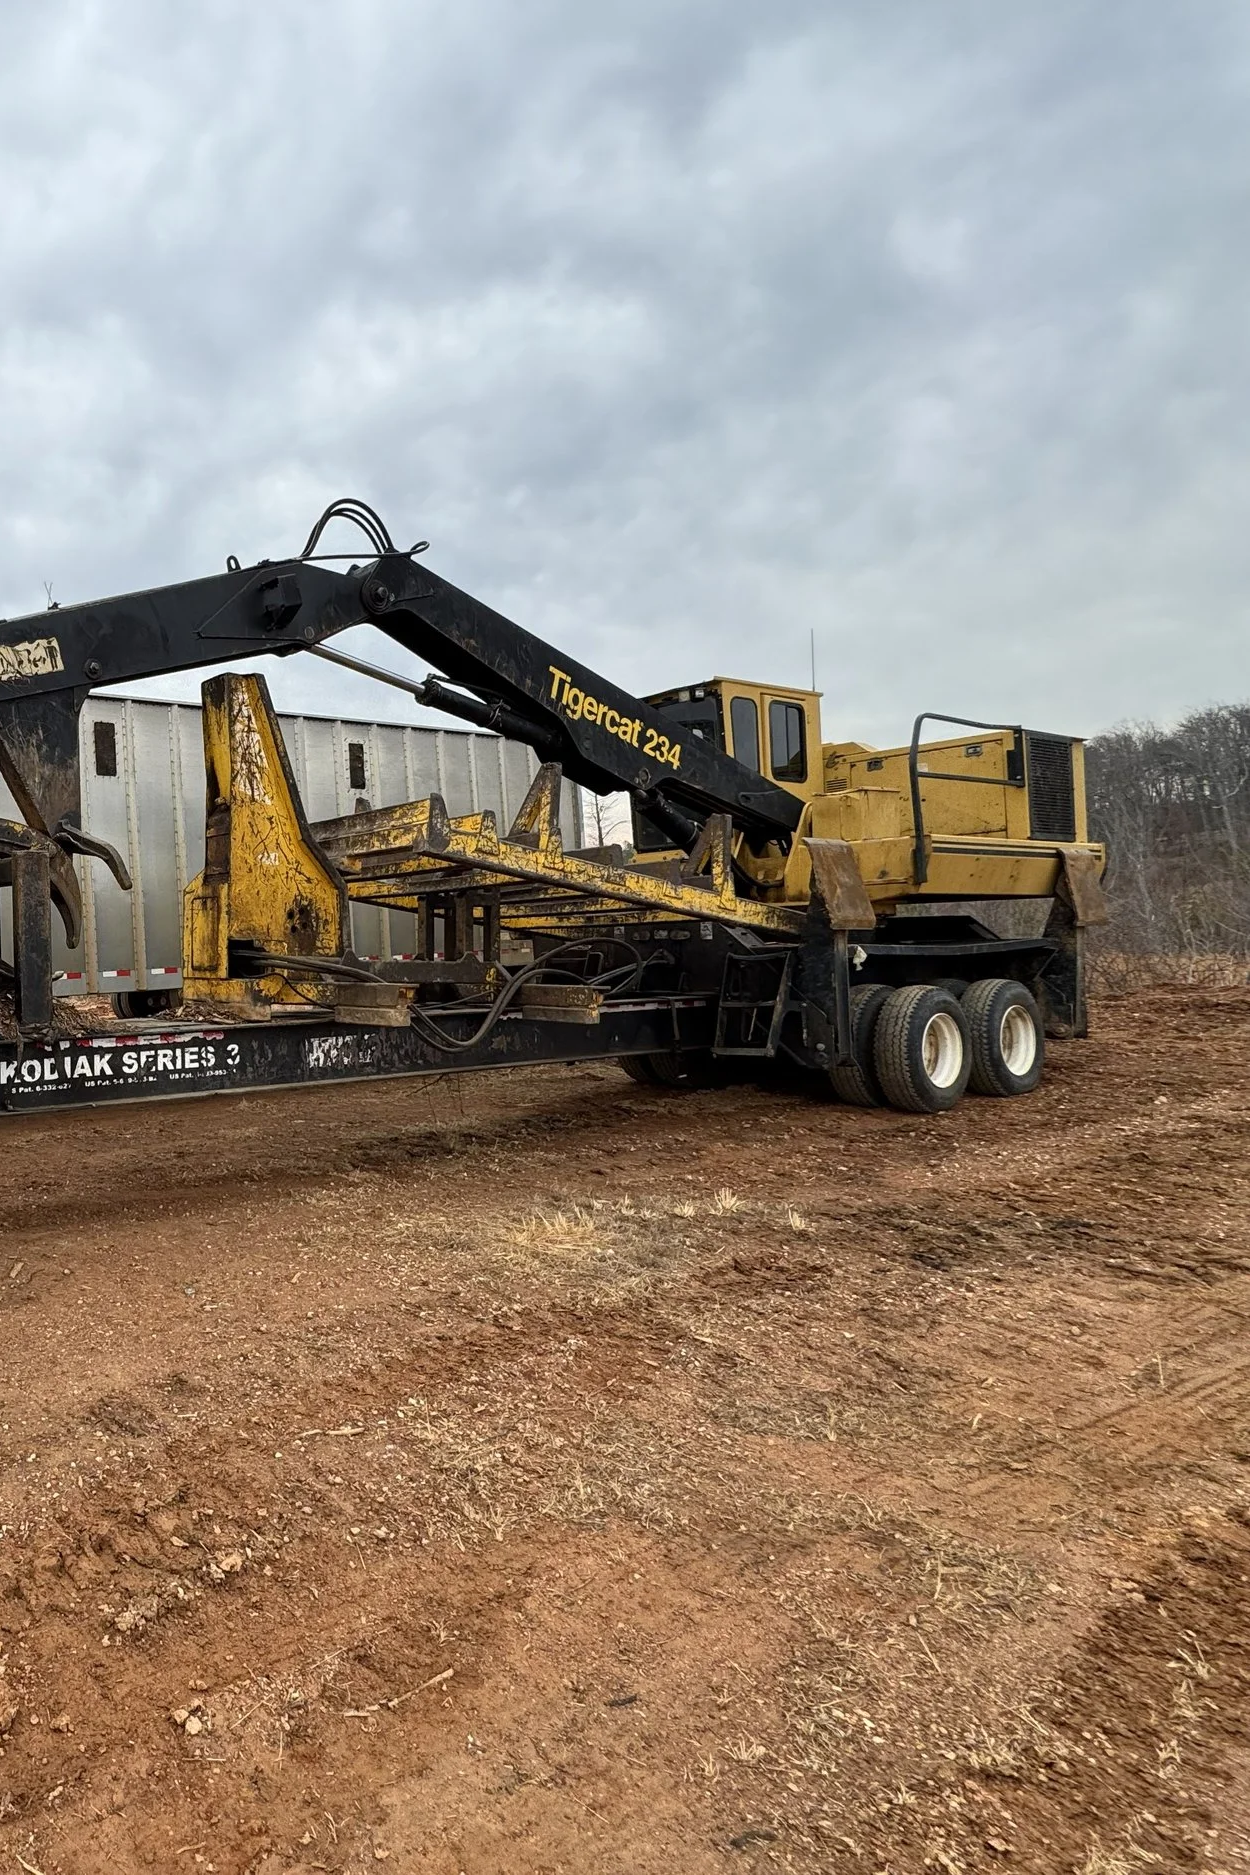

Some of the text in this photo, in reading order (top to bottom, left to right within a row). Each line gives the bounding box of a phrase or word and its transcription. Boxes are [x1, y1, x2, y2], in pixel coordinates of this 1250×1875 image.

[549, 665, 681, 770] Tigercat 234
[122, 1046, 216, 1074] SERIES
[226, 1044, 240, 1065] 3
